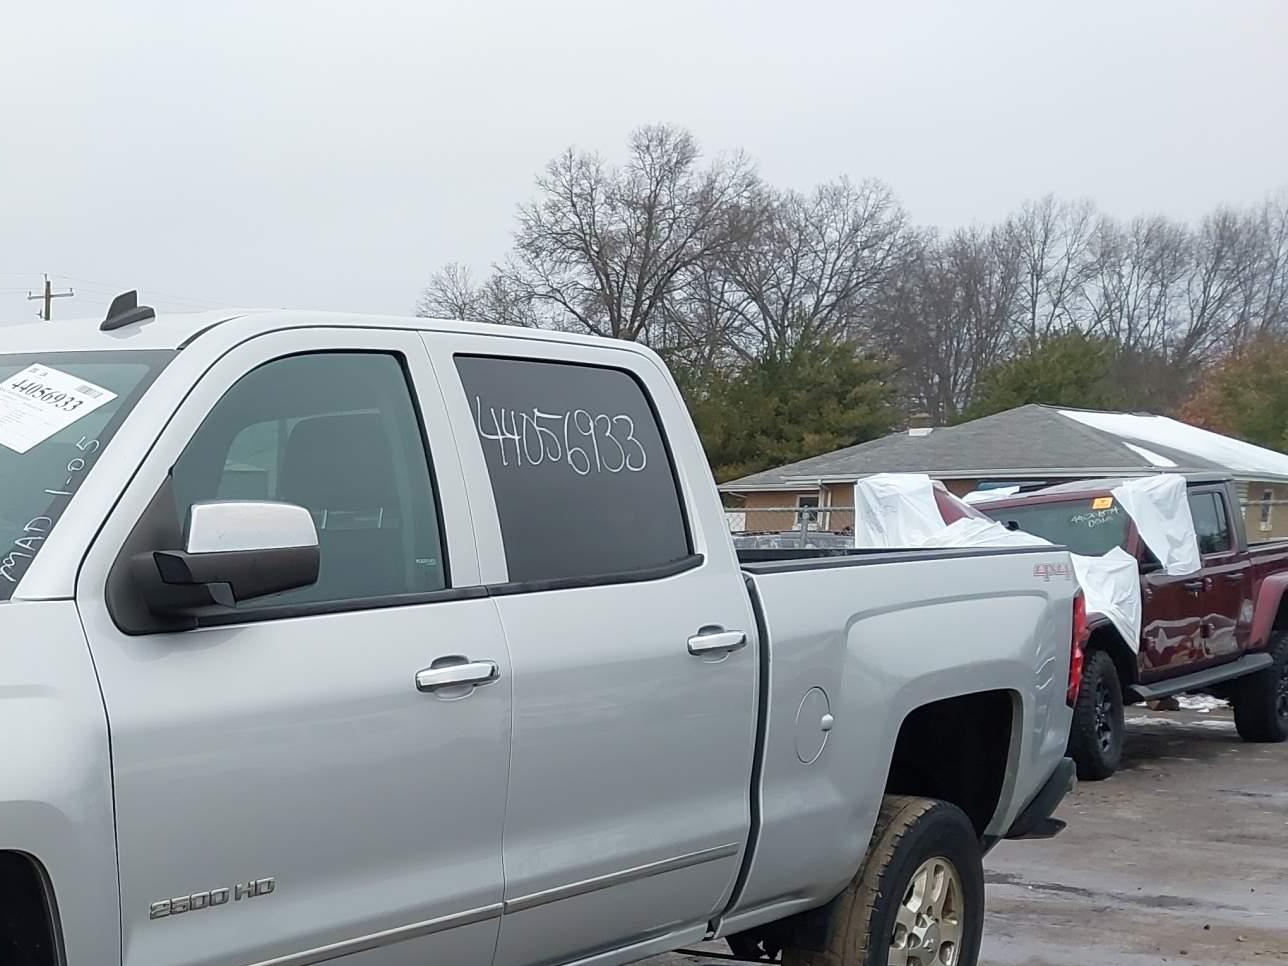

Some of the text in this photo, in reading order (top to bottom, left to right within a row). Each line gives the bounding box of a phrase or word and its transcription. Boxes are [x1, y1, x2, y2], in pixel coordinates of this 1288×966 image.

[12, 379, 84, 412] 44056933
[476, 396, 647, 475] 44056933
[150, 876, 275, 920] 2500 HD
